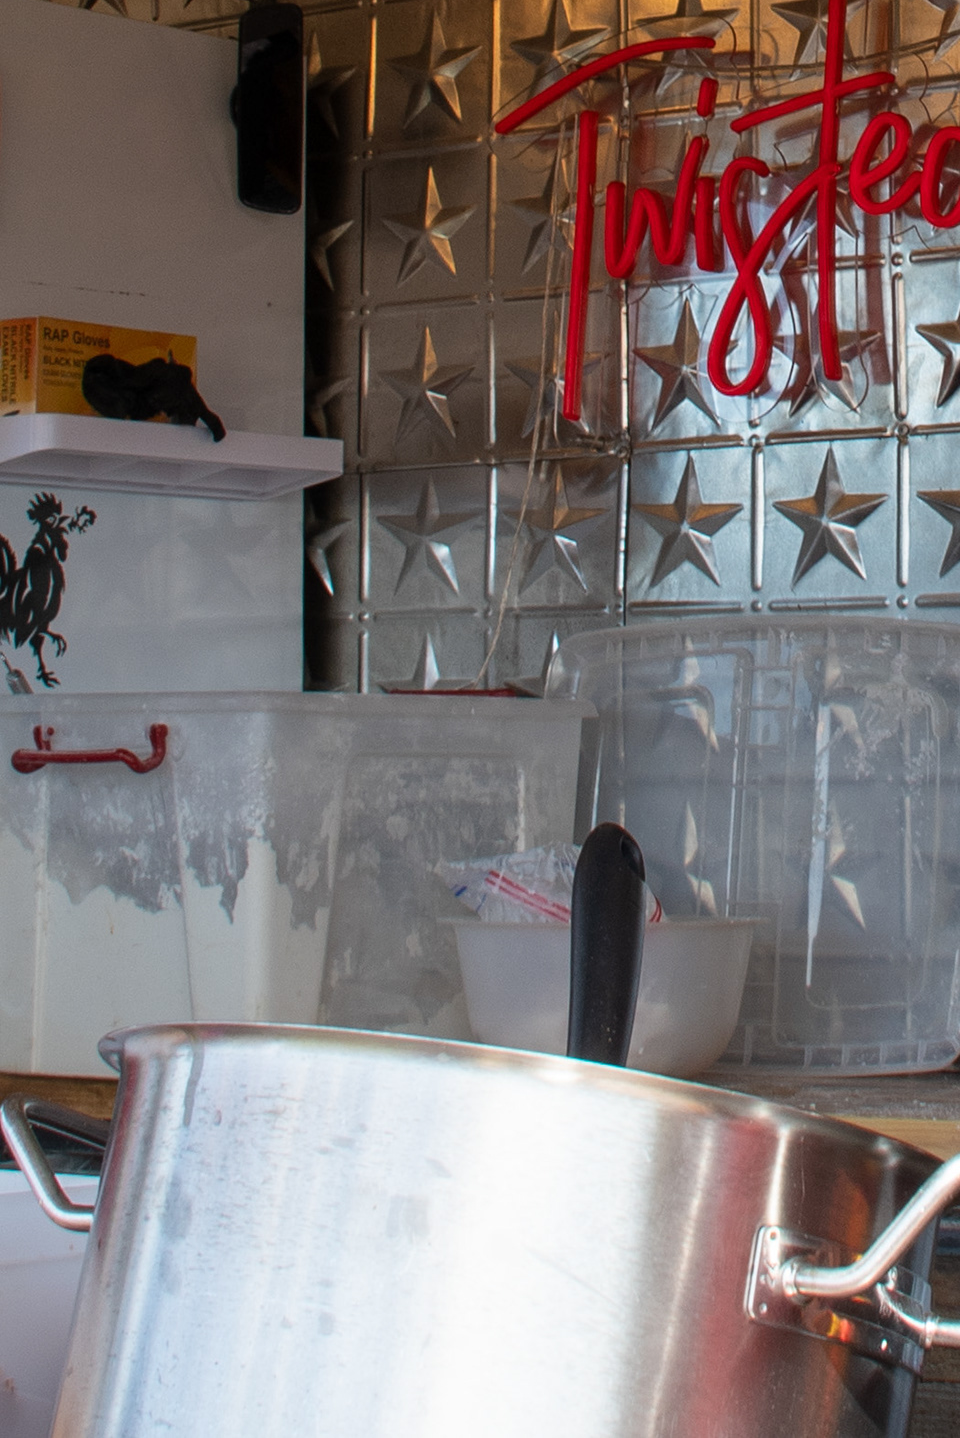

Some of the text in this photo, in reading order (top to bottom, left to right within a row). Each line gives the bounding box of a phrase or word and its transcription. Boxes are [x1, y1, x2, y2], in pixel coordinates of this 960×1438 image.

[42, 326, 111, 349] RAP Gloves
[42, 355, 86, 368] BLACK NIT
